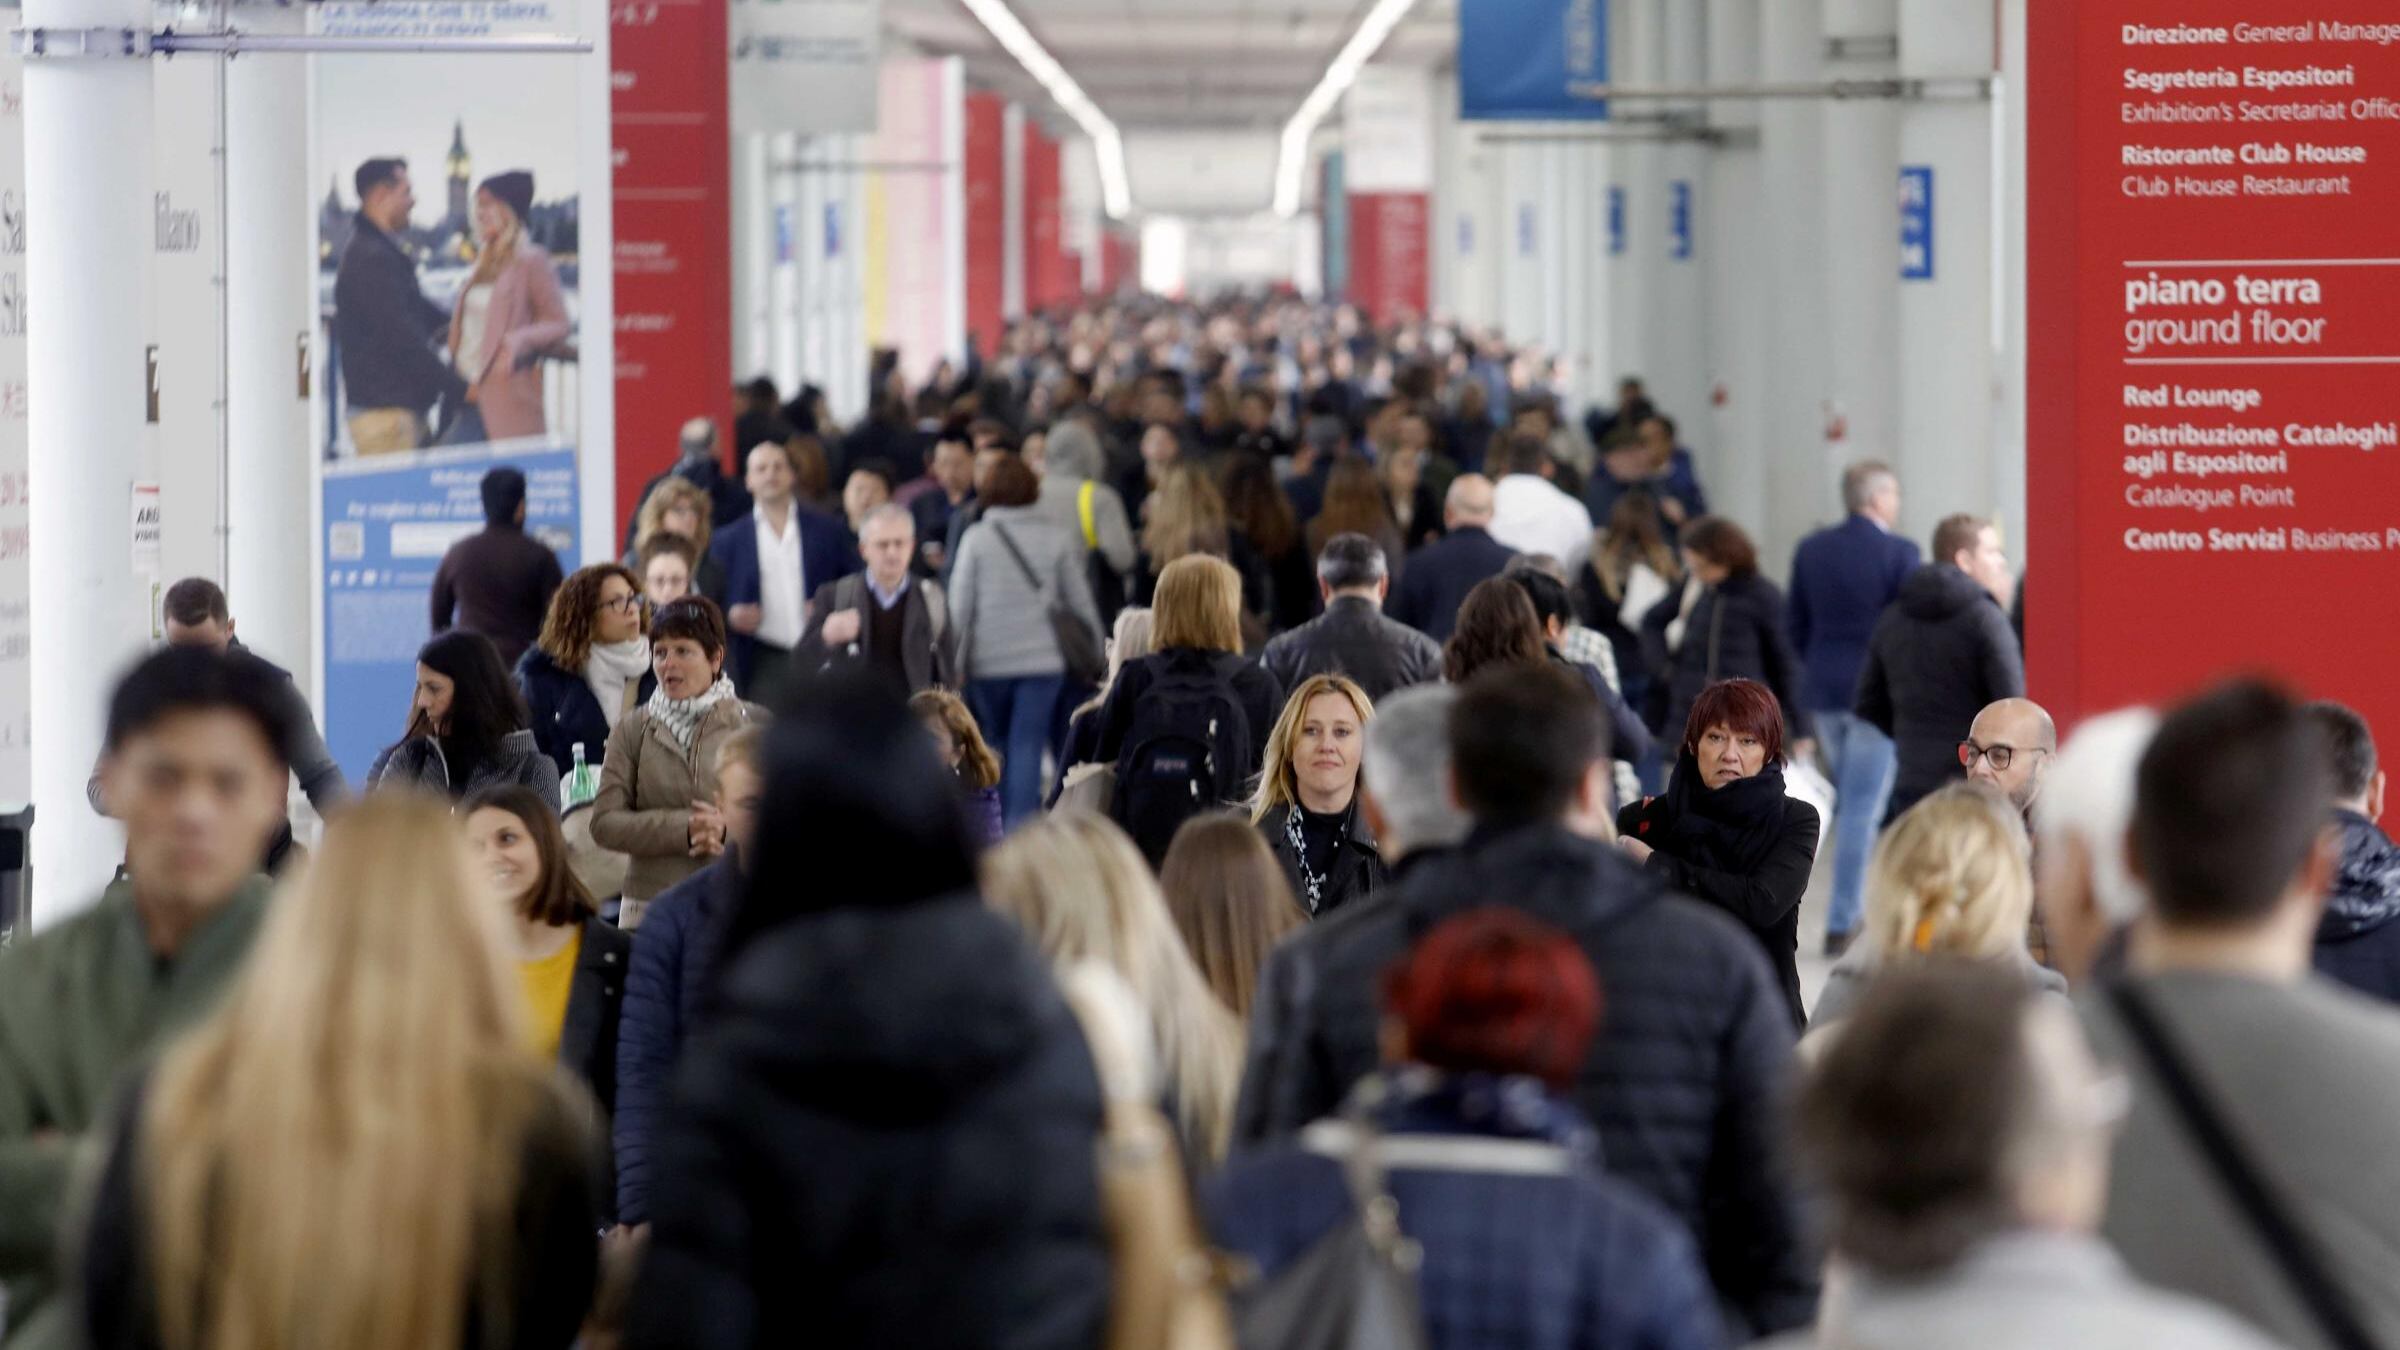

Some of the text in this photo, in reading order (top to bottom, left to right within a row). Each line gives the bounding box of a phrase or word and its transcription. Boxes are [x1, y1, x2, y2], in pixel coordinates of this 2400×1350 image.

[2122, 21, 2400, 46] Direzione General Manage
[2123, 65, 2355, 93] Segreteria Espositori
[2238, 100, 2346, 121] Secretariat
[2121, 142, 2367, 166] Ristorante Club House
[2121, 174, 2350, 197] Club House Restaurant
[2125, 271, 2322, 312] piano terra
[2124, 310, 2327, 353] ground floor
[2123, 385, 2262, 412] Red Lounge
[2123, 422, 2398, 450] Distribuzione Cataloghi
[2123, 451, 2288, 478] agli Espositori
[2124, 483, 2296, 511] Catalogue Point
[2124, 528, 2203, 550] Centro
[2208, 528, 2286, 550] Servizi
[2291, 530, 2382, 551] Business
